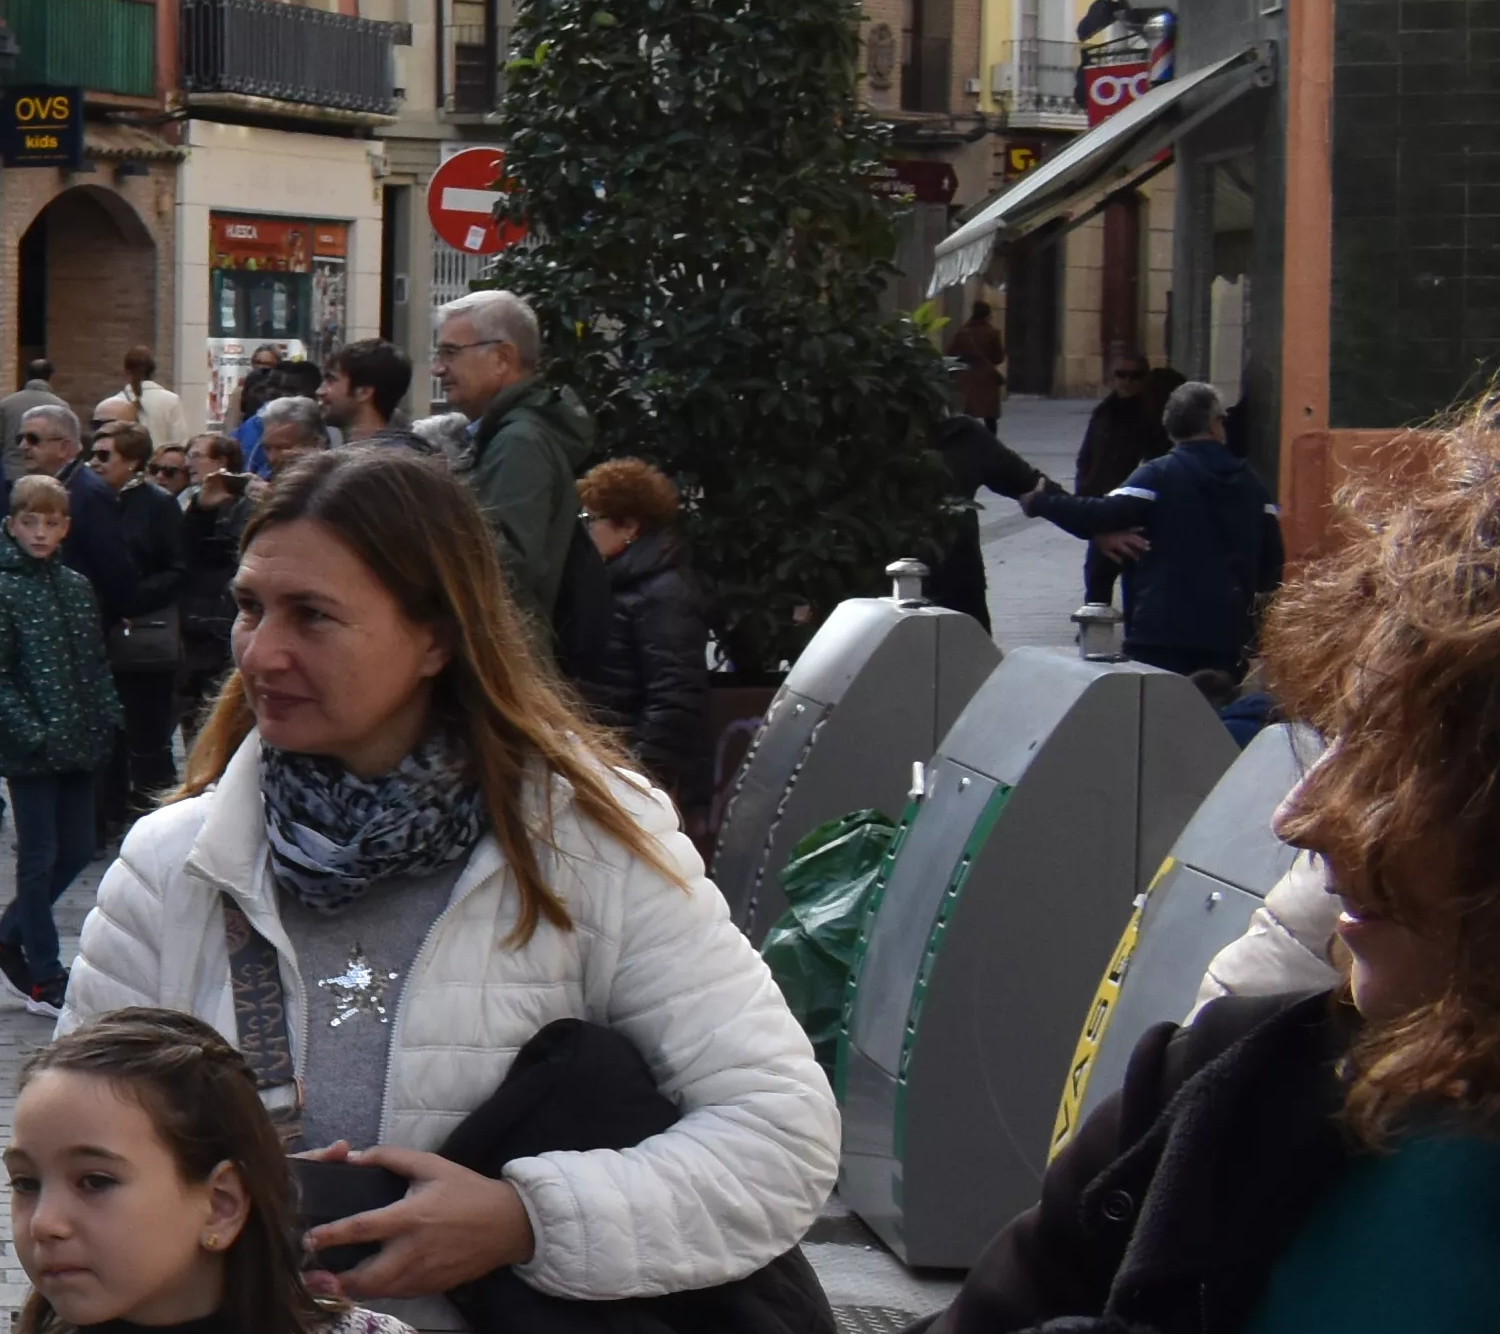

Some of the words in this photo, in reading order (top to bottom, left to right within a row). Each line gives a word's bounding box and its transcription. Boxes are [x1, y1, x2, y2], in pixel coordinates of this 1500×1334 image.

[15, 95, 70, 122] OVS
[25, 134, 59, 150] kids
[225, 224, 258, 239] HUESCA
